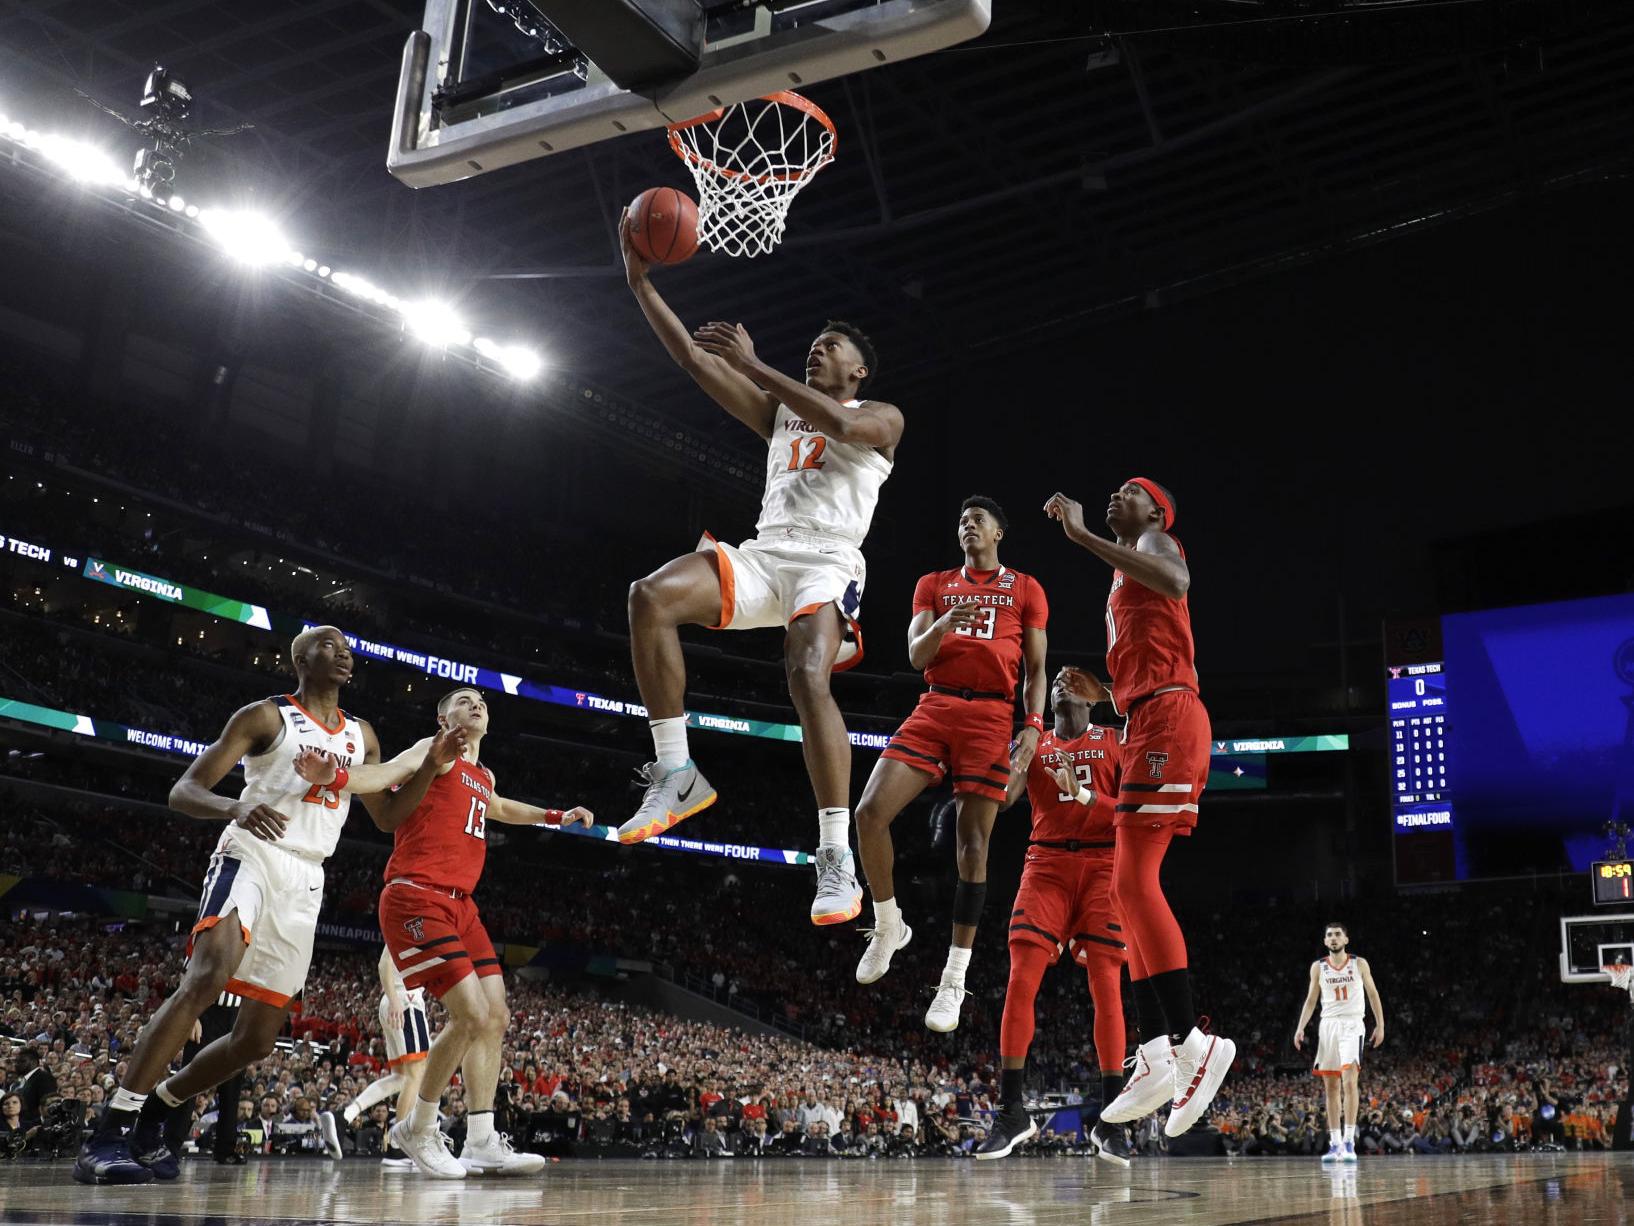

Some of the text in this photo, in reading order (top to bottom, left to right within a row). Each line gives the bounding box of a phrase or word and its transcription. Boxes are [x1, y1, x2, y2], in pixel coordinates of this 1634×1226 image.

[788, 436, 827, 471] 12
[8, 538, 51, 562] TECH
[114, 569, 183, 601] VIRGINIA
[983, 595, 1014, 607] TECH
[359, 639, 395, 659] THERE
[396, 649, 426, 668] WERE
[427, 655, 480, 685] FOUR
[1415, 678, 1425, 696] 0
[587, 695, 623, 713] TEXAS
[624, 703, 649, 718] TEC
[698, 715, 751, 732] VIRGINIA
[127, 728, 172, 751] WELCOME
[1233, 740, 1286, 752] VIRGINIA
[1040, 749, 1104, 765] TEXS TECH
[461, 771, 482, 793] TEXAS
[464, 796, 487, 840] 13
[1397, 811, 1451, 827] #FINALFOUR
[660, 837, 680, 847] THEN
[680, 839, 703, 850] THERE
[704, 843, 724, 853] WERE
[724, 844, 761, 860] FOUR
[1623, 877, 1629, 897] 1
[314, 922, 383, 943] INNEAPOLI
[1325, 976, 1354, 985] VIRGINIA
[1334, 985, 1349, 1001] 11
